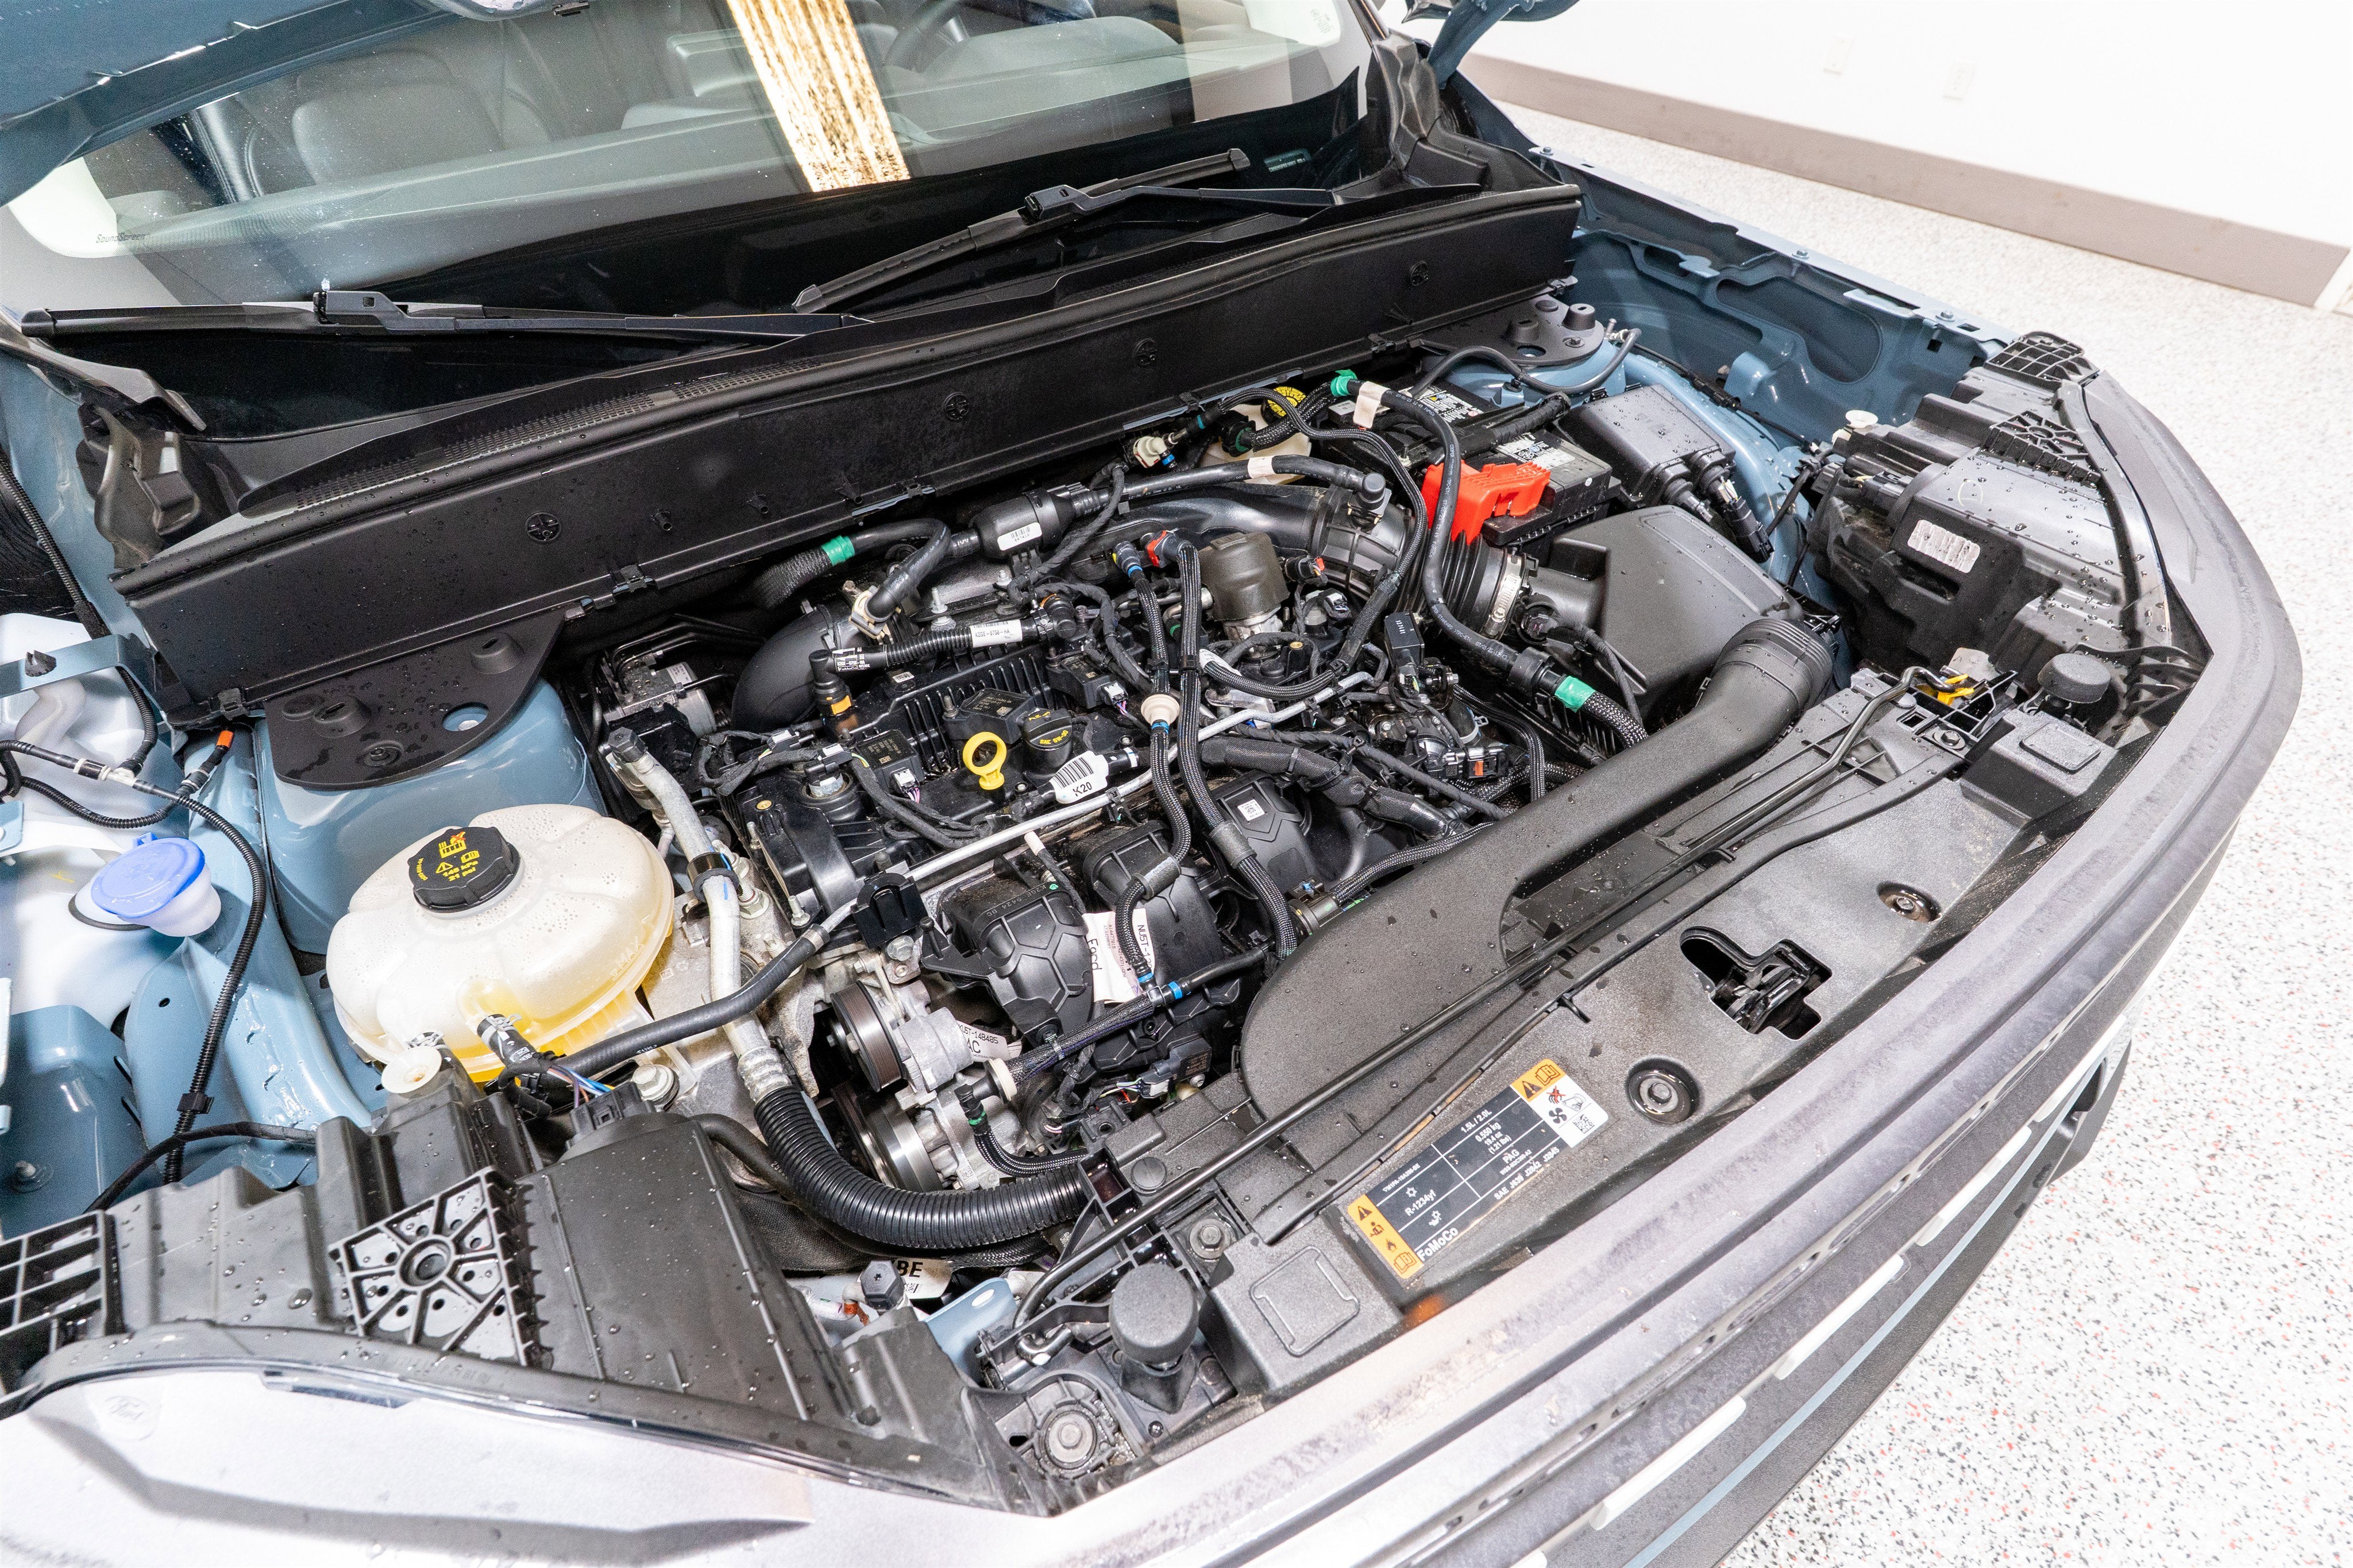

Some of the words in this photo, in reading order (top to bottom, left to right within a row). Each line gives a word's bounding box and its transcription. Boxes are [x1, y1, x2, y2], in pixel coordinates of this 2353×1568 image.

[96, 233, 145, 243] SoundScreen
[1073, 782, 1093, 797] K20
[1460, 1121, 1476, 1133] 1.5L
[1476, 1109, 1492, 1122] 2.0L
[1475, 1126, 1493, 1142] 0.550
[1490, 1122, 1502, 1131] kg
[1495, 1131, 1503, 1139] oz
[1502, 1149, 1520, 1164] PAG
[1494, 1186, 1509, 1200] SAE
[1509, 1175, 1525, 1188] J639
[1405, 1189, 1437, 1216] R-1234yf
[1417, 1225, 1459, 1262] FoMoCo
